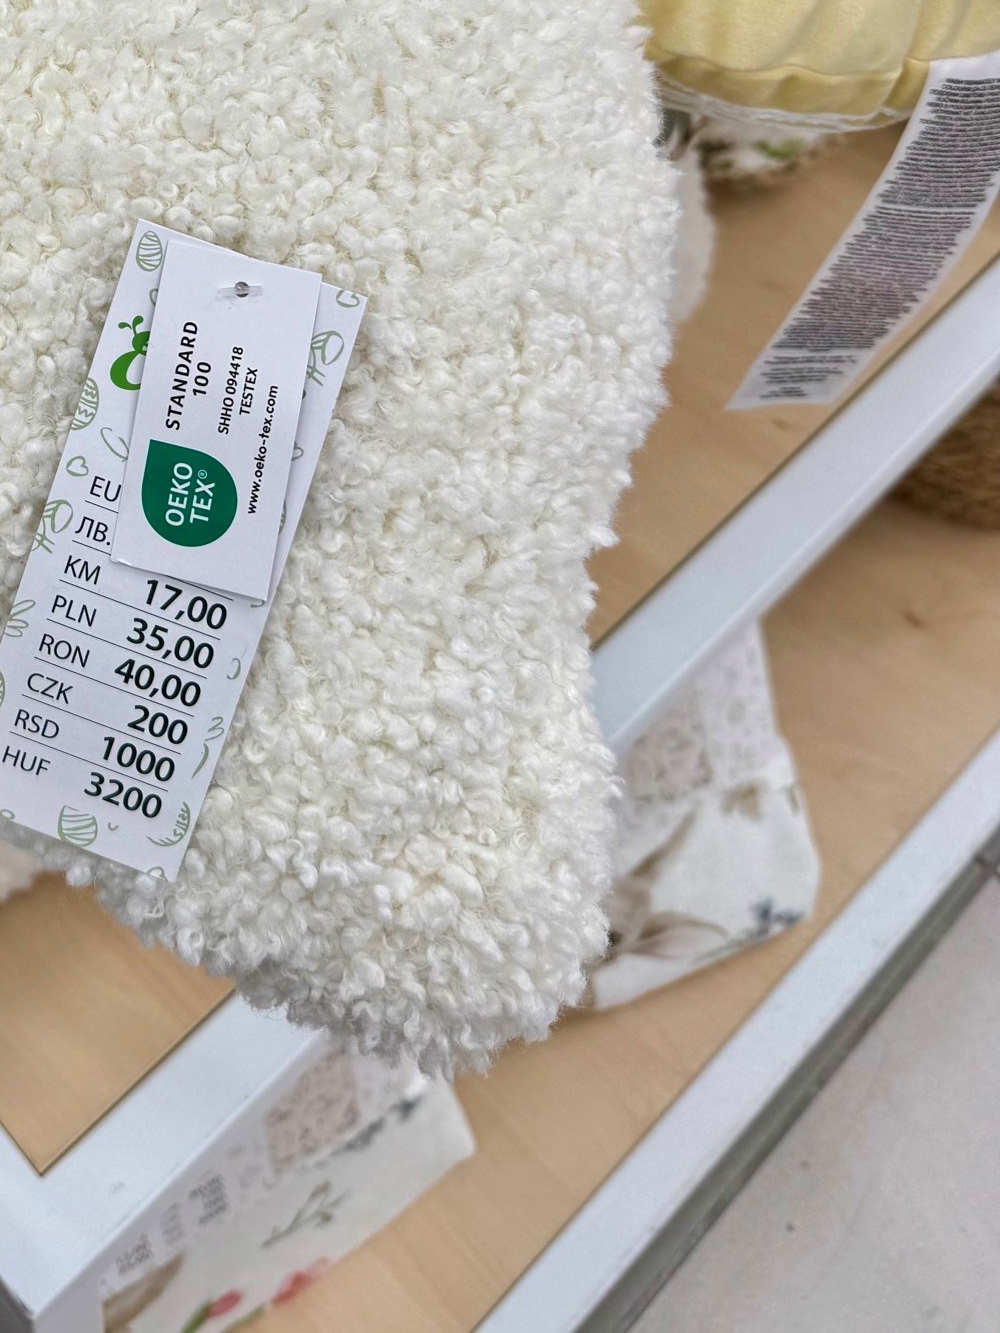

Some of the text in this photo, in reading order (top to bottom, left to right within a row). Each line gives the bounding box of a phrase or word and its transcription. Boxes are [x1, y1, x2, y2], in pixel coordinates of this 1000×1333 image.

[165, 321, 198, 431] STANDARD
[192, 361, 212, 397] 100
[218, 346, 244, 435] SHHO 094418
[239, 367, 258, 416] TESTEX
[248, 385, 278, 514] www.oeko-tex.com
[89, 475, 122, 503] EU
[165, 462, 193, 526] OEKO
[63, 554, 228, 630] KM 17,00
[51, 594, 215, 669] PLN 35,00
[38, 633, 201, 707] RON 40,00
[14, 708, 175, 782] RSD 1000
[27, 672, 188, 745] CZK 200
[2, 745, 162, 819] HUF 3200
